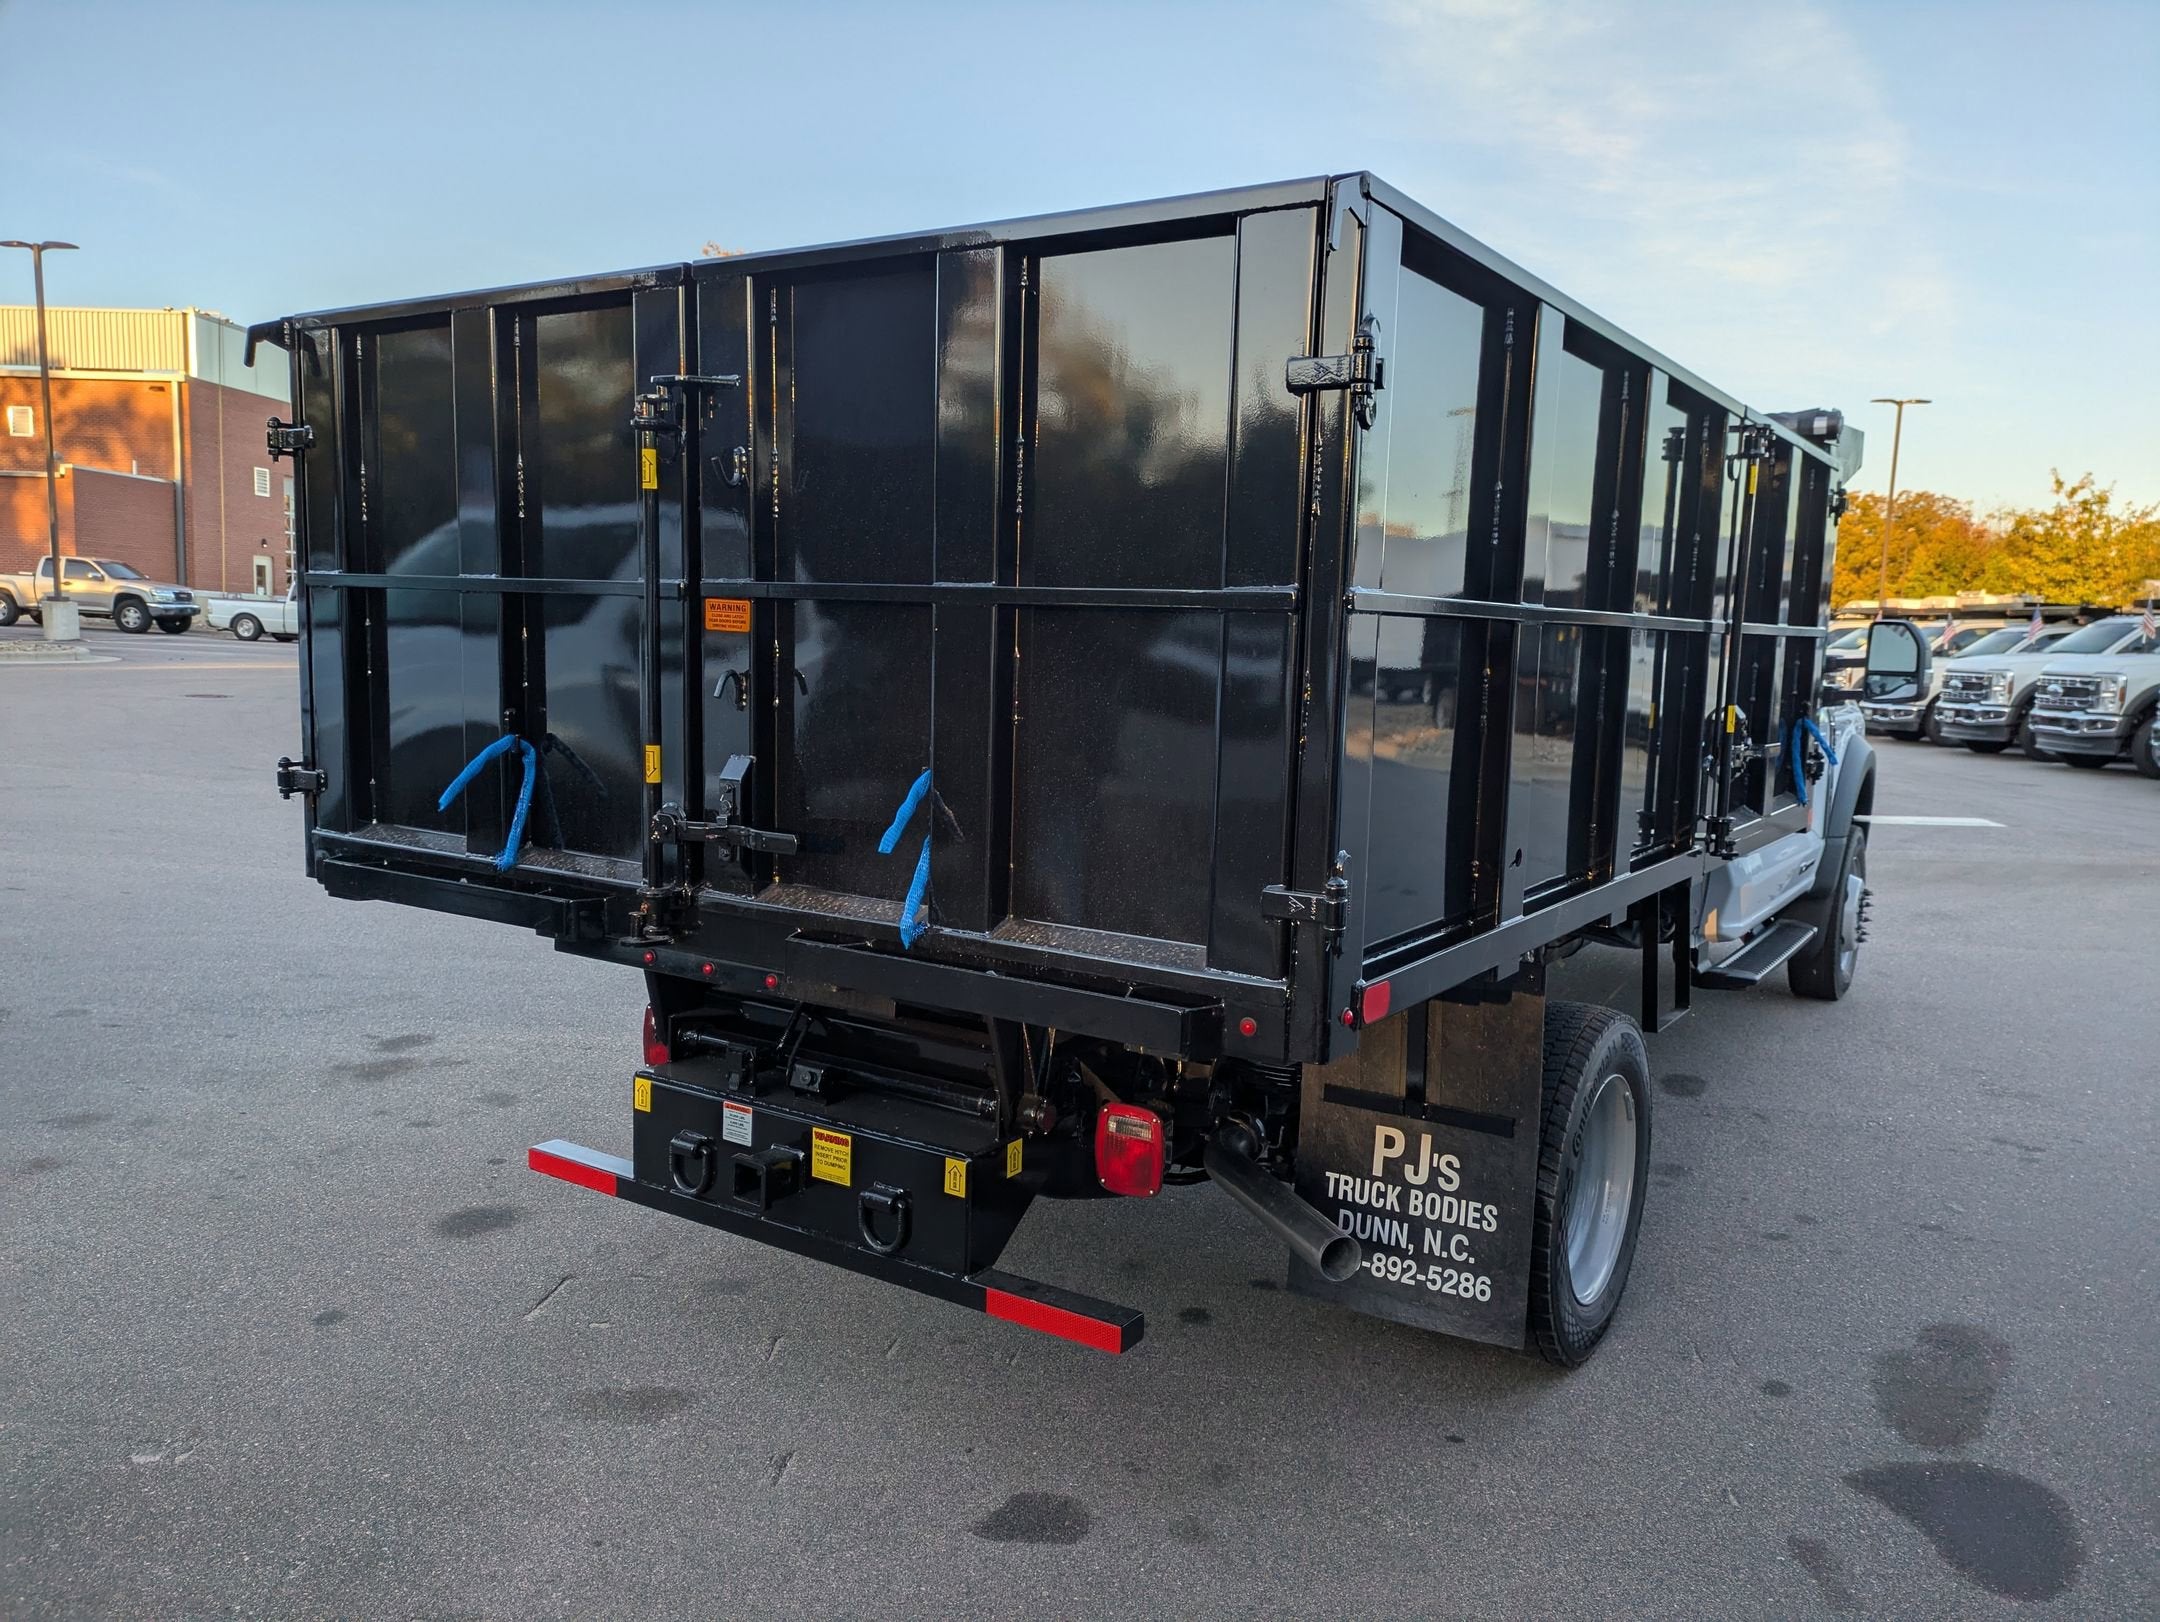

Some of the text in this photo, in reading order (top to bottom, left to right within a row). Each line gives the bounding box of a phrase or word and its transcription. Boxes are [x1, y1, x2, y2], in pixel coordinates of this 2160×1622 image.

[710, 603, 747, 612] WARNING
[814, 1131, 849, 1147] WARNING
[814, 1144, 833, 1153] REMOVE
[832, 1155, 848, 1163] PRIOR
[824, 1161, 846, 1170] DUMPING
[1325, 1171, 1498, 1233] TRUCK BODIES
[1338, 1208, 1475, 1264] DUNN, N.C.
[1357, 1252, 1492, 1302] -892-5286
